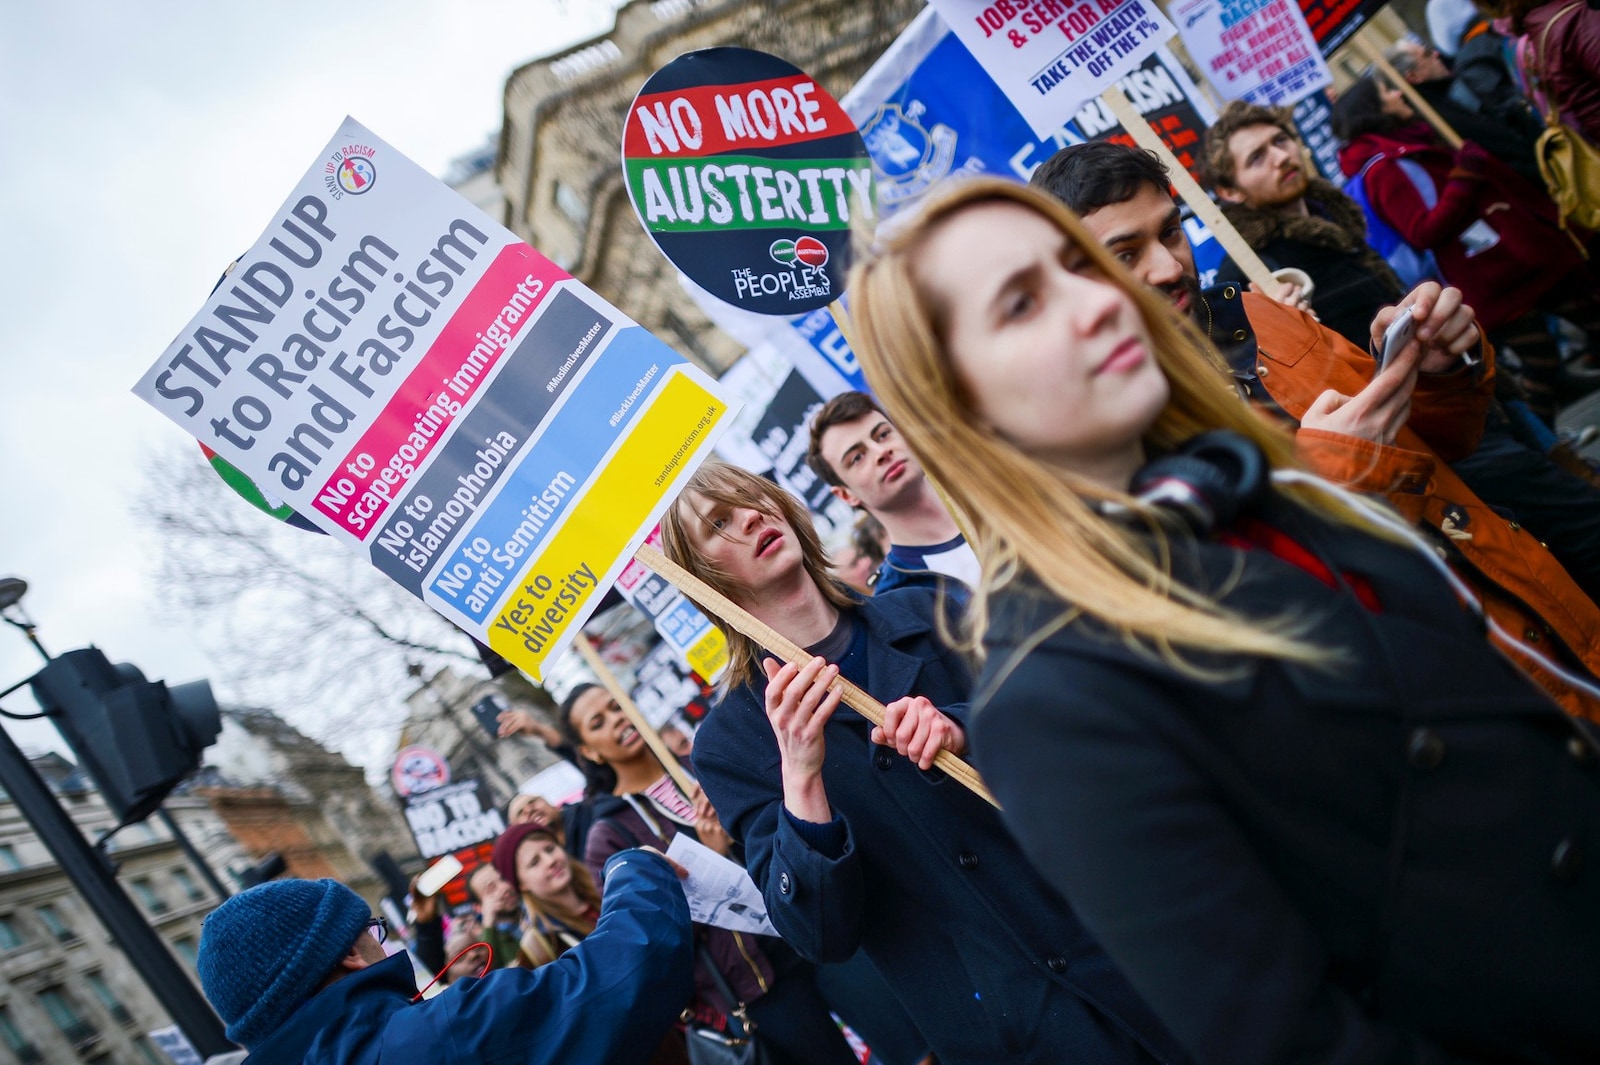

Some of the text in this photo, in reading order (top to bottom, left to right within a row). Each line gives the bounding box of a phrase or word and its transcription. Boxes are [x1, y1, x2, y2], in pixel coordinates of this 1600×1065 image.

[1007, 28, 1028, 48] &
[1031, 60, 1071, 95] TAKE
[1065, 39, 1094, 67] THE
[1091, 1, 1146, 48] WEALTH
[1057, 3, 1100, 42] FOR
[1087, 17, 1159, 78] OFF THE 1%
[636, 97, 703, 155] NO
[714, 82, 827, 142] MORE
[325, 144, 376, 200] STAND UP TO RACISM
[642, 164, 875, 225] AUSTERITY
[731, 267, 752, 278] THE
[734, 267, 831, 299] PEOPLE'S
[788, 285, 831, 300] ASSEMBLY
[155, 195, 337, 417] STAND UP
[209, 235, 400, 451] to Racism
[268, 218, 489, 492] and Fascism
[545, 321, 603, 393] #MuslimLivesMatter
[346, 273, 544, 531] scapegoating immigrants
[609, 363, 659, 428] #BlackLivesMatter
[654, 405, 717, 487] standuptoracism.org.uk
[319, 452, 376, 514] No to
[400, 430, 518, 573] islamophobia
[377, 494, 433, 557] No to
[464, 470, 577, 614] anti Semitism
[436, 537, 491, 599] No to
[495, 574, 553, 635] Yes to
[522, 562, 599, 654] diversity
